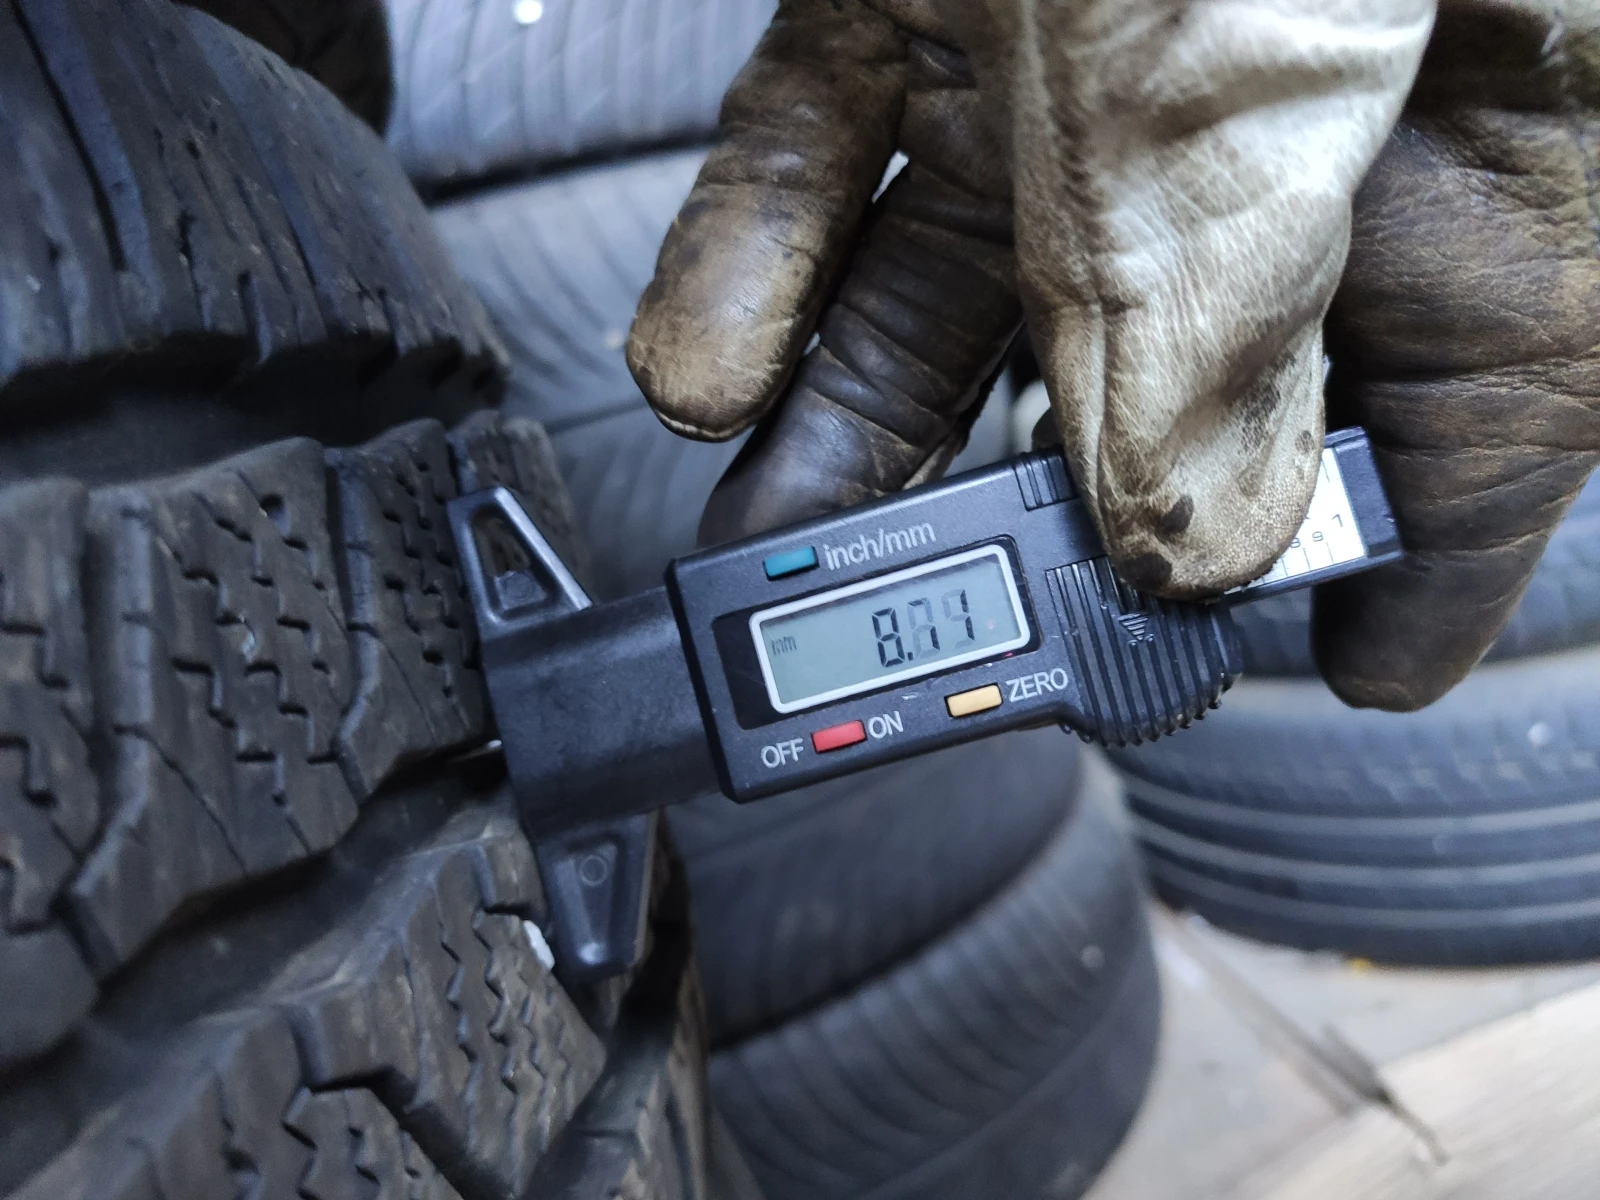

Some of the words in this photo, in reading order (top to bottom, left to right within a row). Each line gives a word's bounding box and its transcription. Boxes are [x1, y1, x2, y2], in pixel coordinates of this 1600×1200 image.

[822, 522, 936, 571] inch/mm
[1006, 667, 1069, 702] ZERO
[760, 738, 804, 769] OFF
[867, 710, 904, 739] ON
